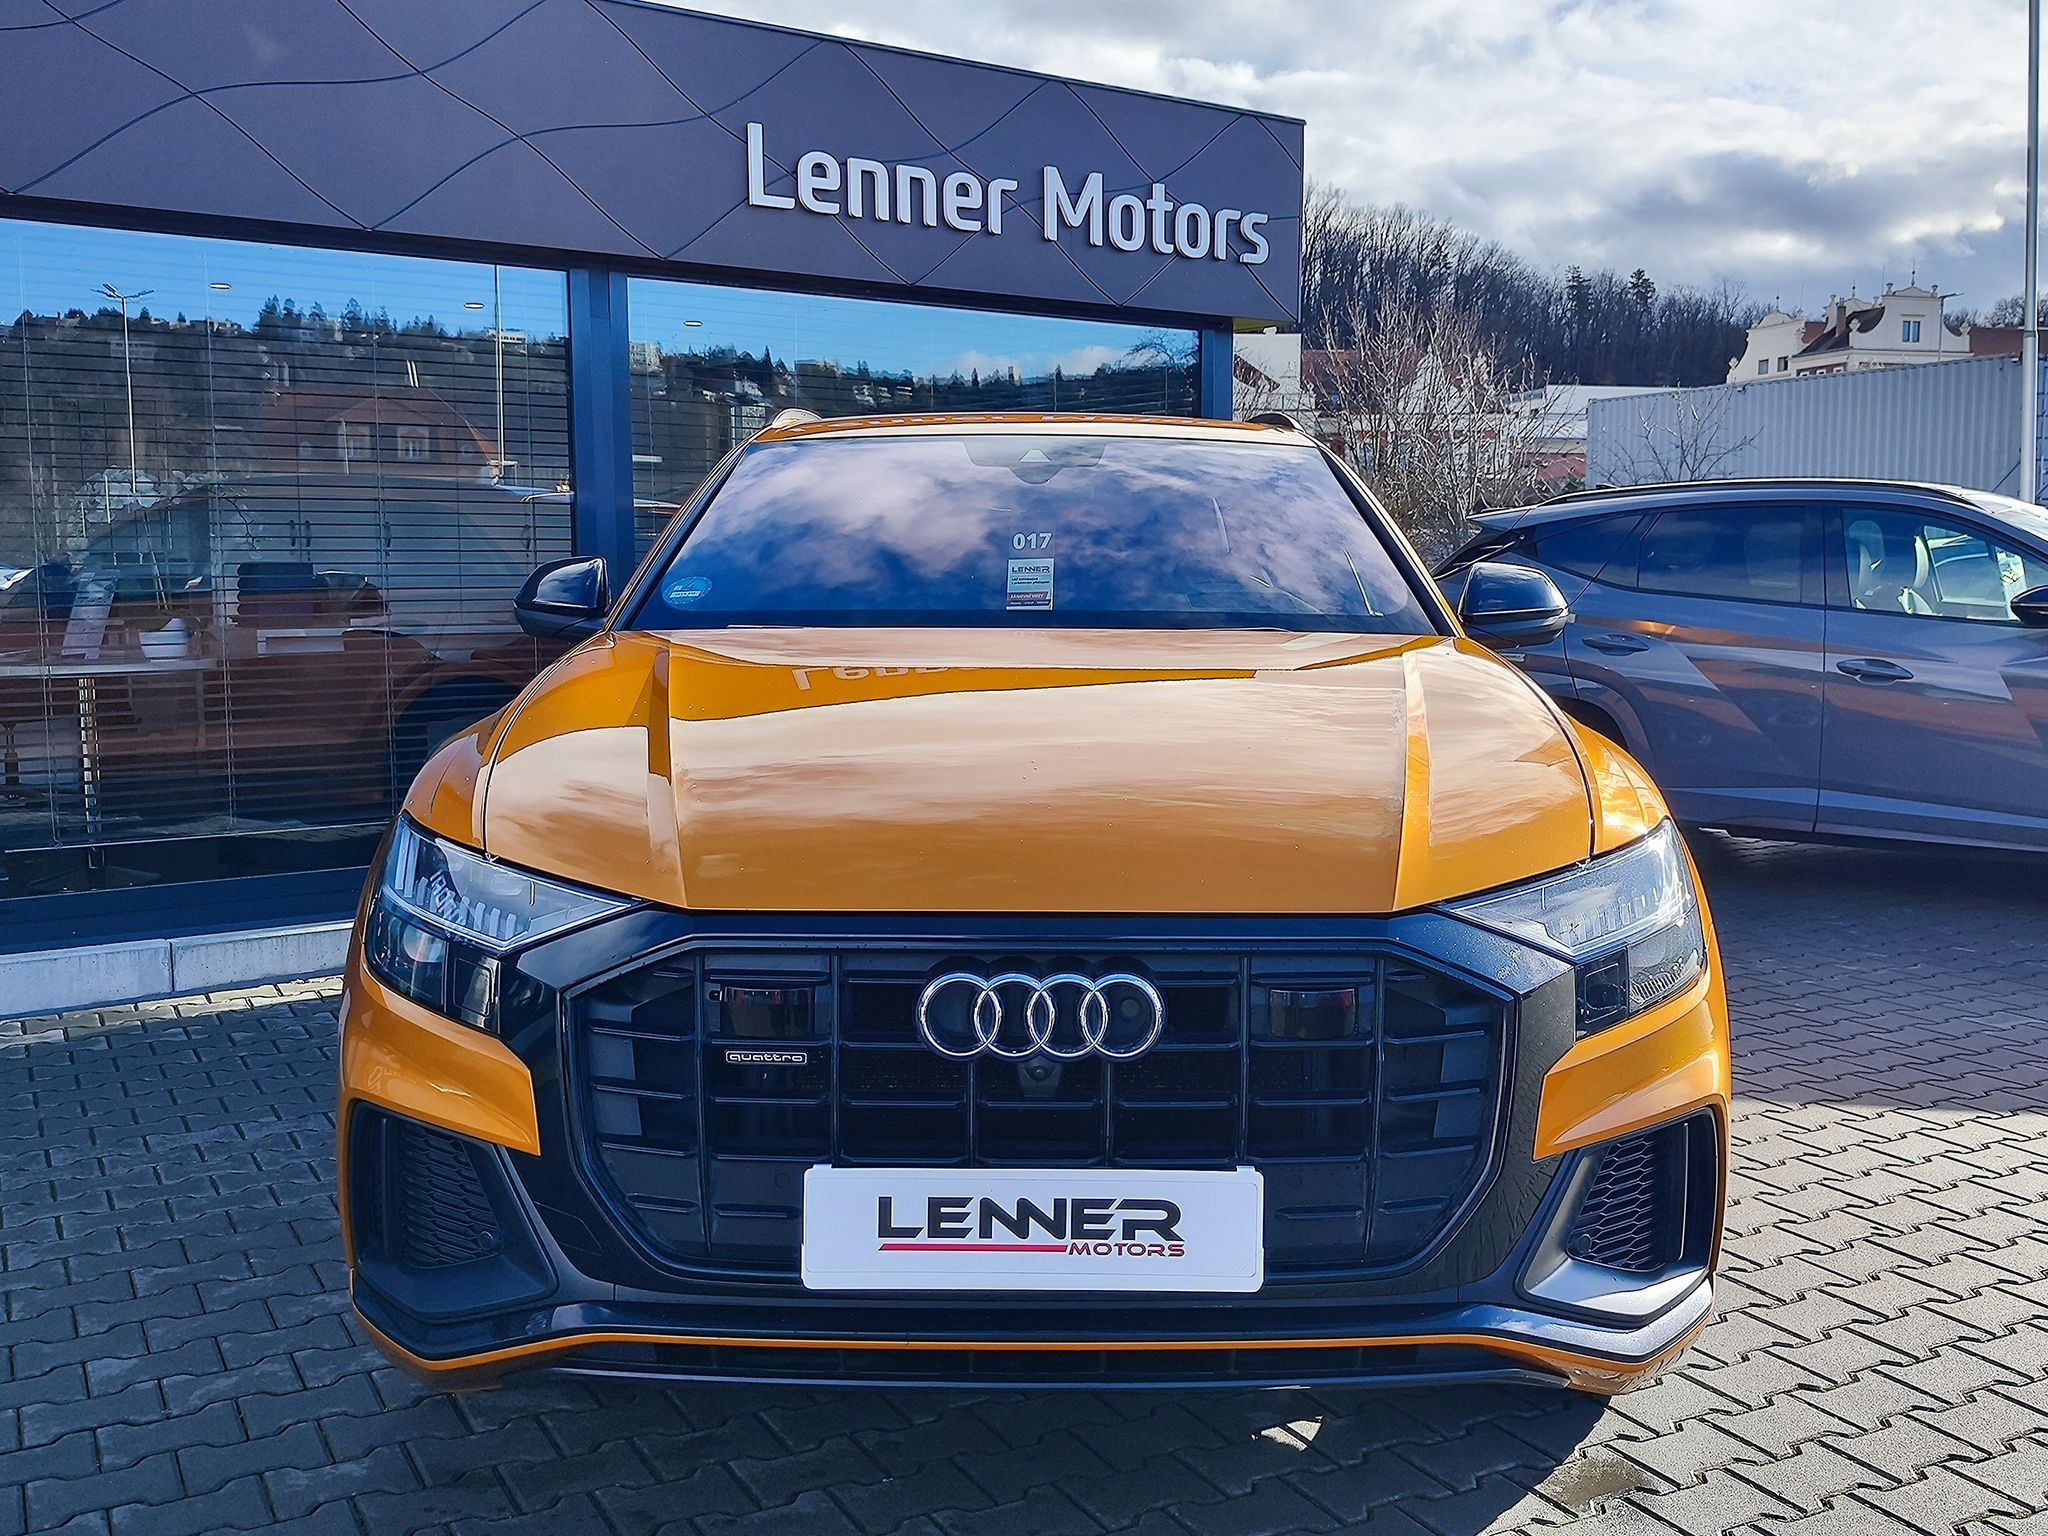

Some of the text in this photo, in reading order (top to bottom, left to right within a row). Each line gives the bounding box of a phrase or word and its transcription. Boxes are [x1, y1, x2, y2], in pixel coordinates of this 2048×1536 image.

[747, 122, 1270, 265] Lenner Motors
[1012, 532, 1052, 550] 017
[1011, 565, 1051, 574] LENNER
[728, 1053, 804, 1062] quattro
[877, 1196, 1182, 1242] LENNER
[1068, 1242, 1186, 1257] MOTORS
